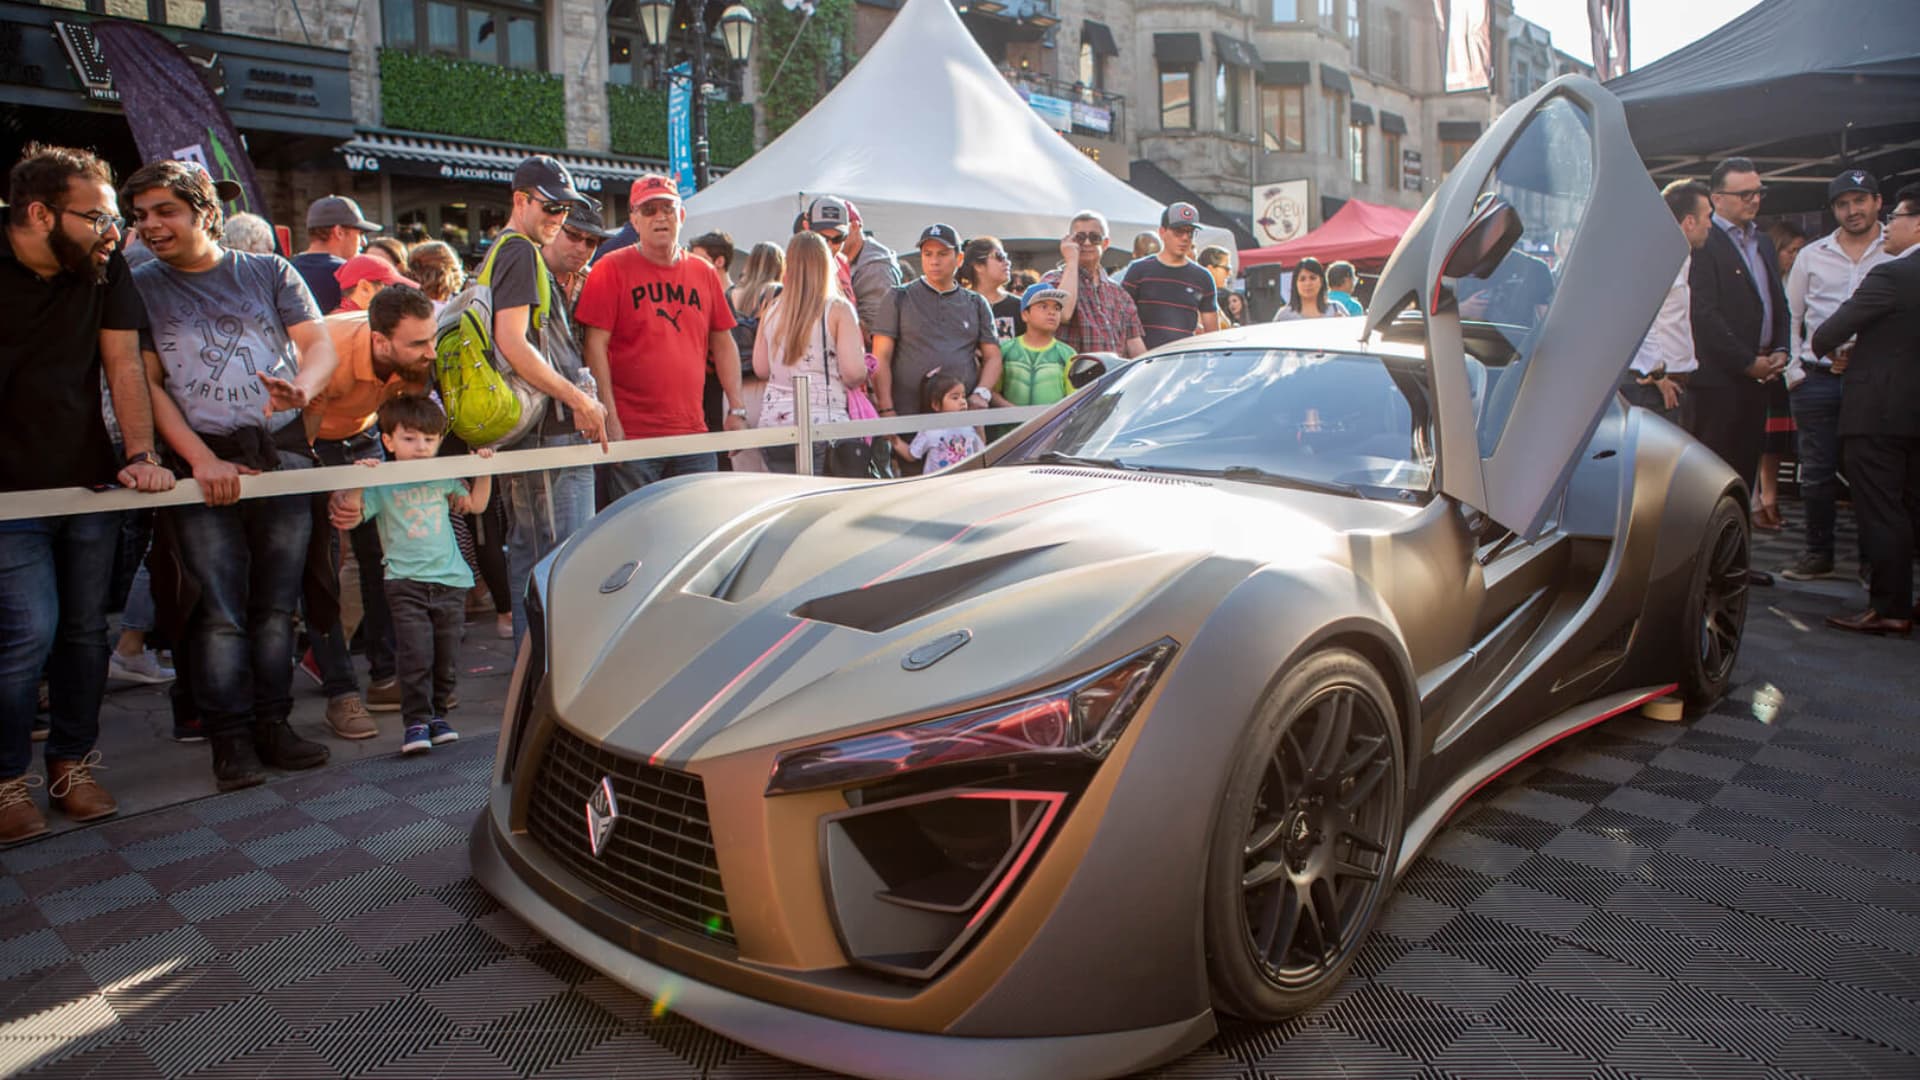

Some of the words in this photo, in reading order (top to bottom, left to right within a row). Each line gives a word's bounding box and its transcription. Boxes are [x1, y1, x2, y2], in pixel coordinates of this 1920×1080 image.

[345, 155, 379, 170] WG
[575, 176, 602, 191] WG
[632, 282, 701, 311] PUMA
[185, 365, 276, 402] ARCHIVS
